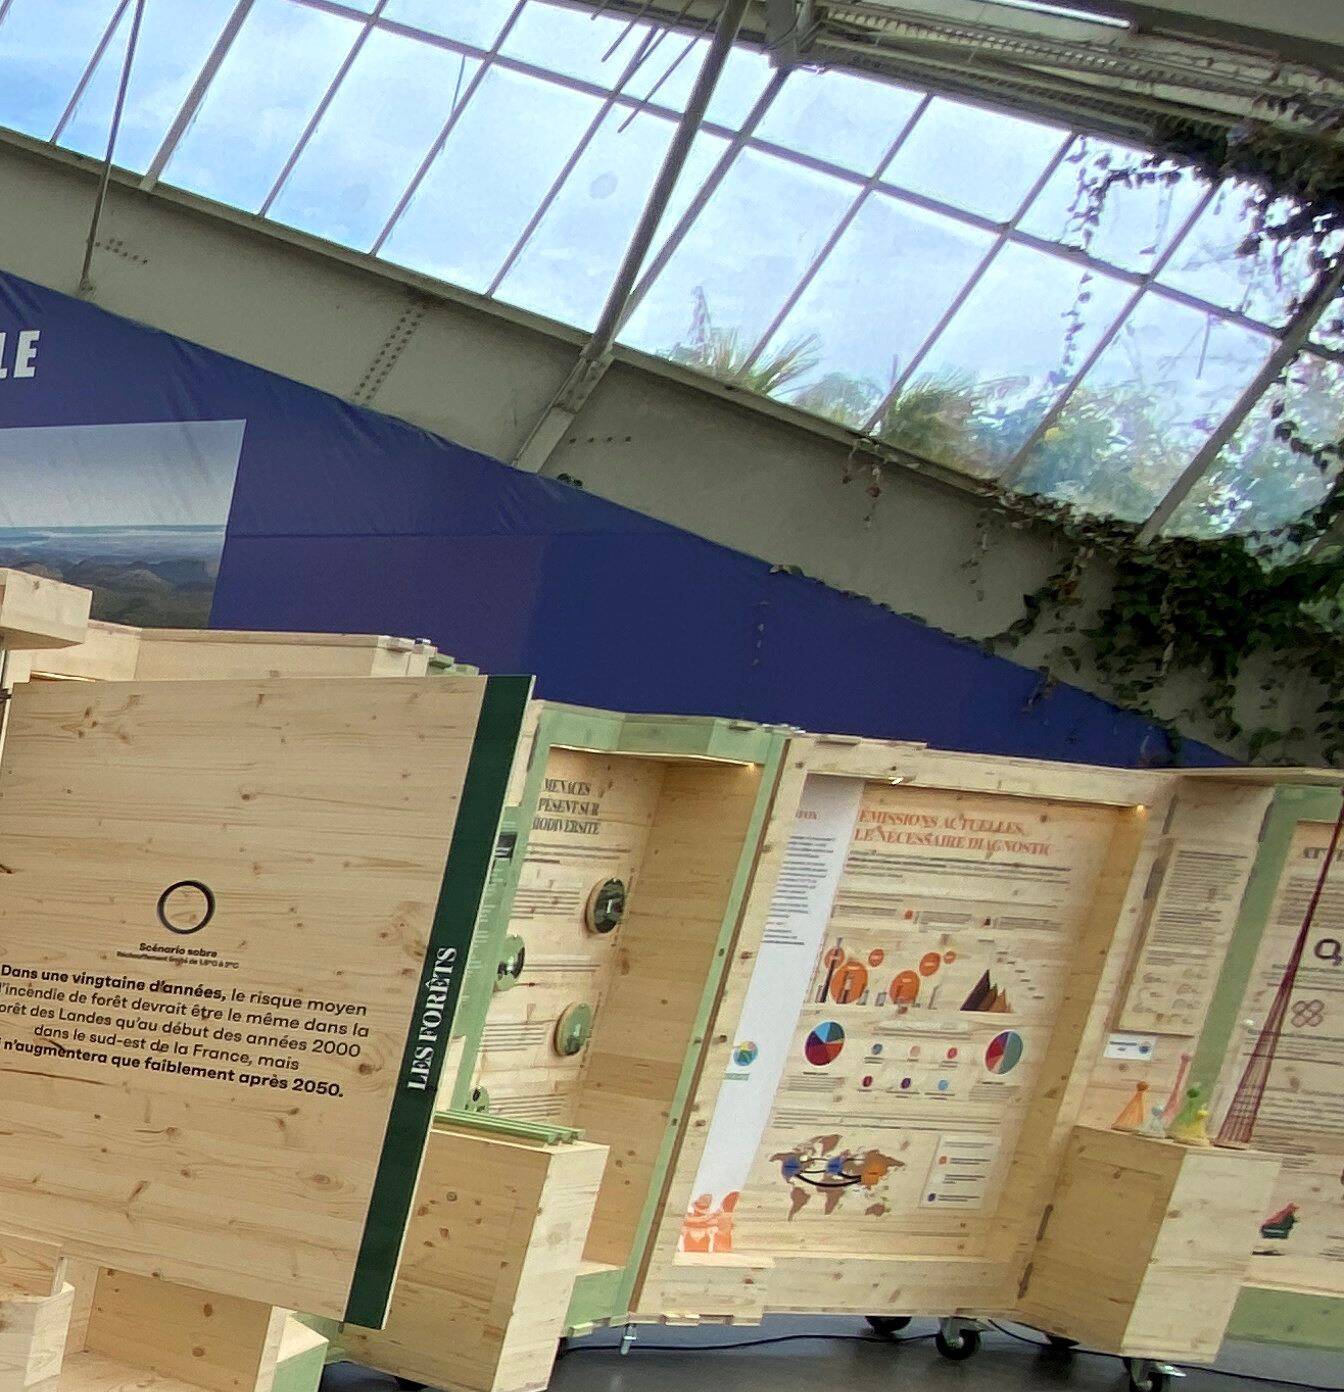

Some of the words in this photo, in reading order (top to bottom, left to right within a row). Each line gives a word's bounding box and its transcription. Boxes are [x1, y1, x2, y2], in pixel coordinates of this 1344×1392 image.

[0, 963, 38, 980] Dans
[40, 971, 69, 983] une
[71, 971, 146, 991] vingtaine
[148, 979, 227, 1002] d'années,
[230, 987, 246, 1002] le
[249, 990, 303, 1010] risque
[307, 1000, 367, 1017] moyen
[68, 990, 88, 1004] de
[91, 992, 129, 1009] forêt
[131, 997, 188, 1016] devrait
[190, 1003, 224, 1020] être
[227, 1007, 242, 1023] le
[245, 1012, 300, 1029] même
[303, 1017, 348, 1035] dans
[352, 1022, 370, 1038] la
[419, 948, 457, 1041] FORÊTS
[29, 1004, 55, 1019] des
[58, 1007, 112, 1026] Landes
[115, 1016, 158, 1032] qu'au
[161, 1020, 210, 1039] début
[212, 1027, 242, 1043] des
[245, 1034, 308, 1051] années
[311, 1038, 361, 1058] 2000
[33, 1023, 70, 1040] dans
[72, 1028, 86, 1042] le
[88, 1033, 147, 1050] sud-est
[149, 1038, 170, 1053] de
[173, 1041, 189, 1056] la
[192, 1043, 253, 1067] France,
[257, 1055, 300, 1071] mais
[3, 1038, 108, 1064] n'augmentera
[110, 1055, 141, 1068] que
[144, 1056, 236, 1082] faiblement
[238, 1073, 289, 1090] après
[291, 1077, 344, 1098] 2050.
[407, 1046, 434, 1090] LES
